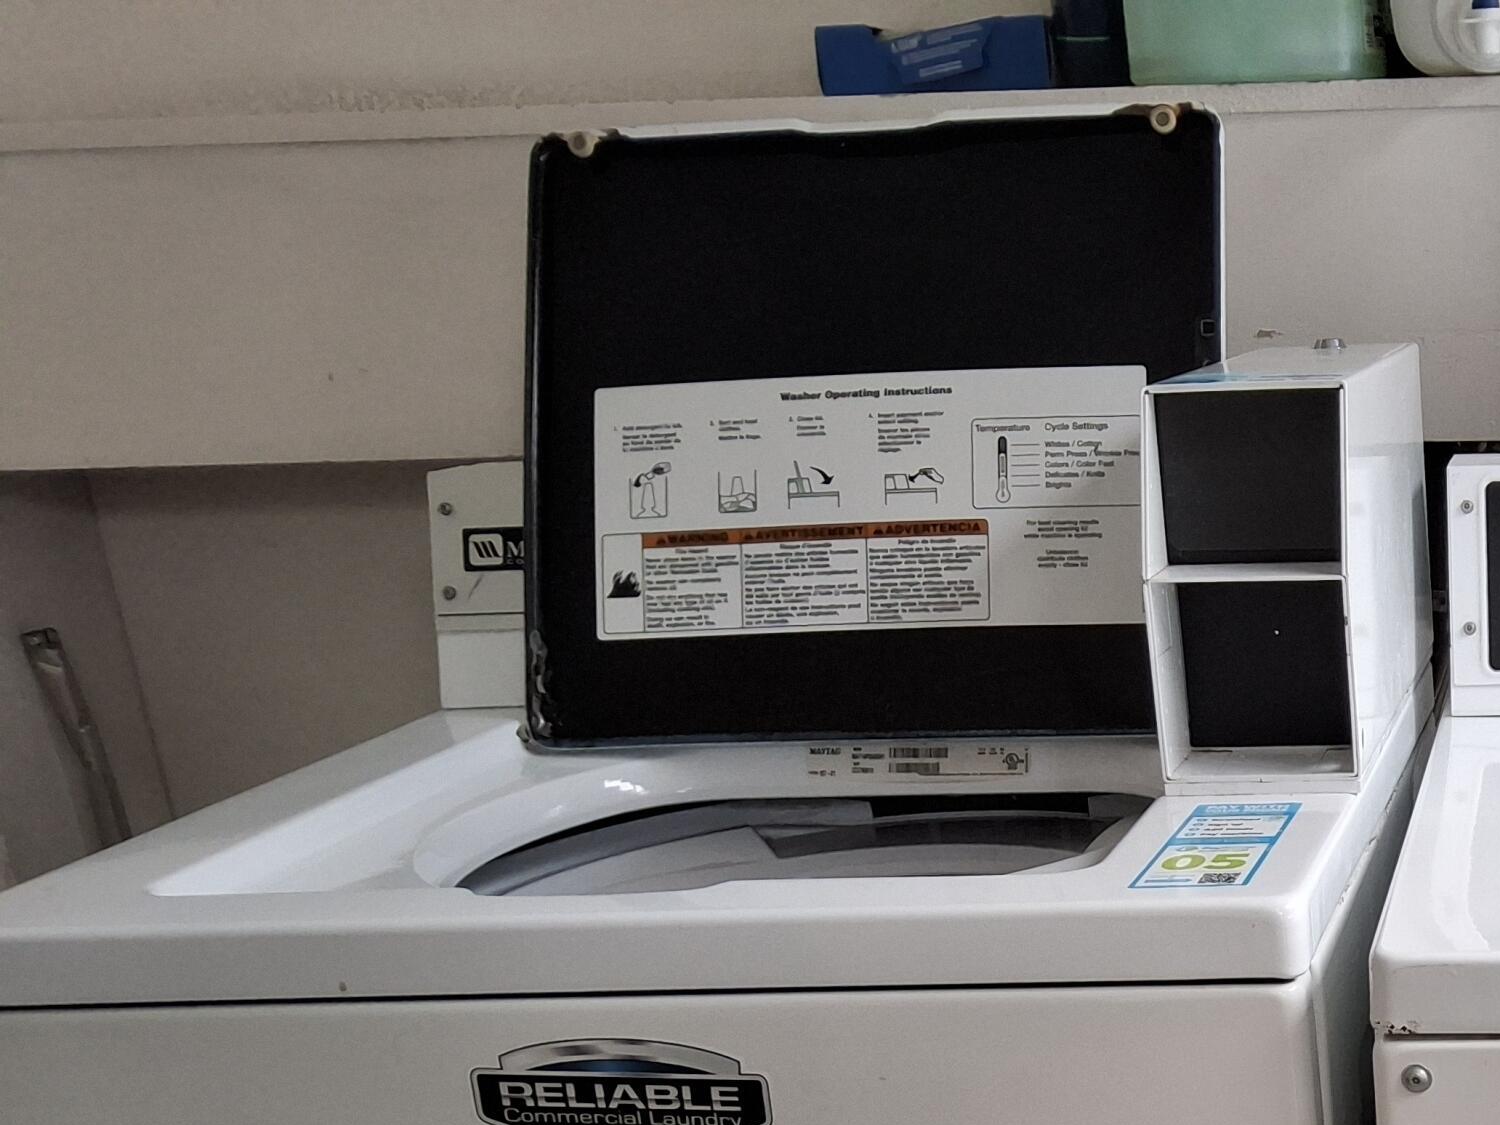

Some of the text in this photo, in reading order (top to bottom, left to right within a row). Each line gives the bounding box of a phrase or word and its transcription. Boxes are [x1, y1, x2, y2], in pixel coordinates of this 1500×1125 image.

[780, 386, 953, 401] Washer Operating Instructions
[976, 422, 1108, 433] Temperature Cycle Settings
[884, 522, 981, 535] ADVERTENCIA
[1161, 853, 1250, 871] 05
[498, 1081, 742, 1112] RELIABLE
[504, 1107, 642, 1125] Commercial
